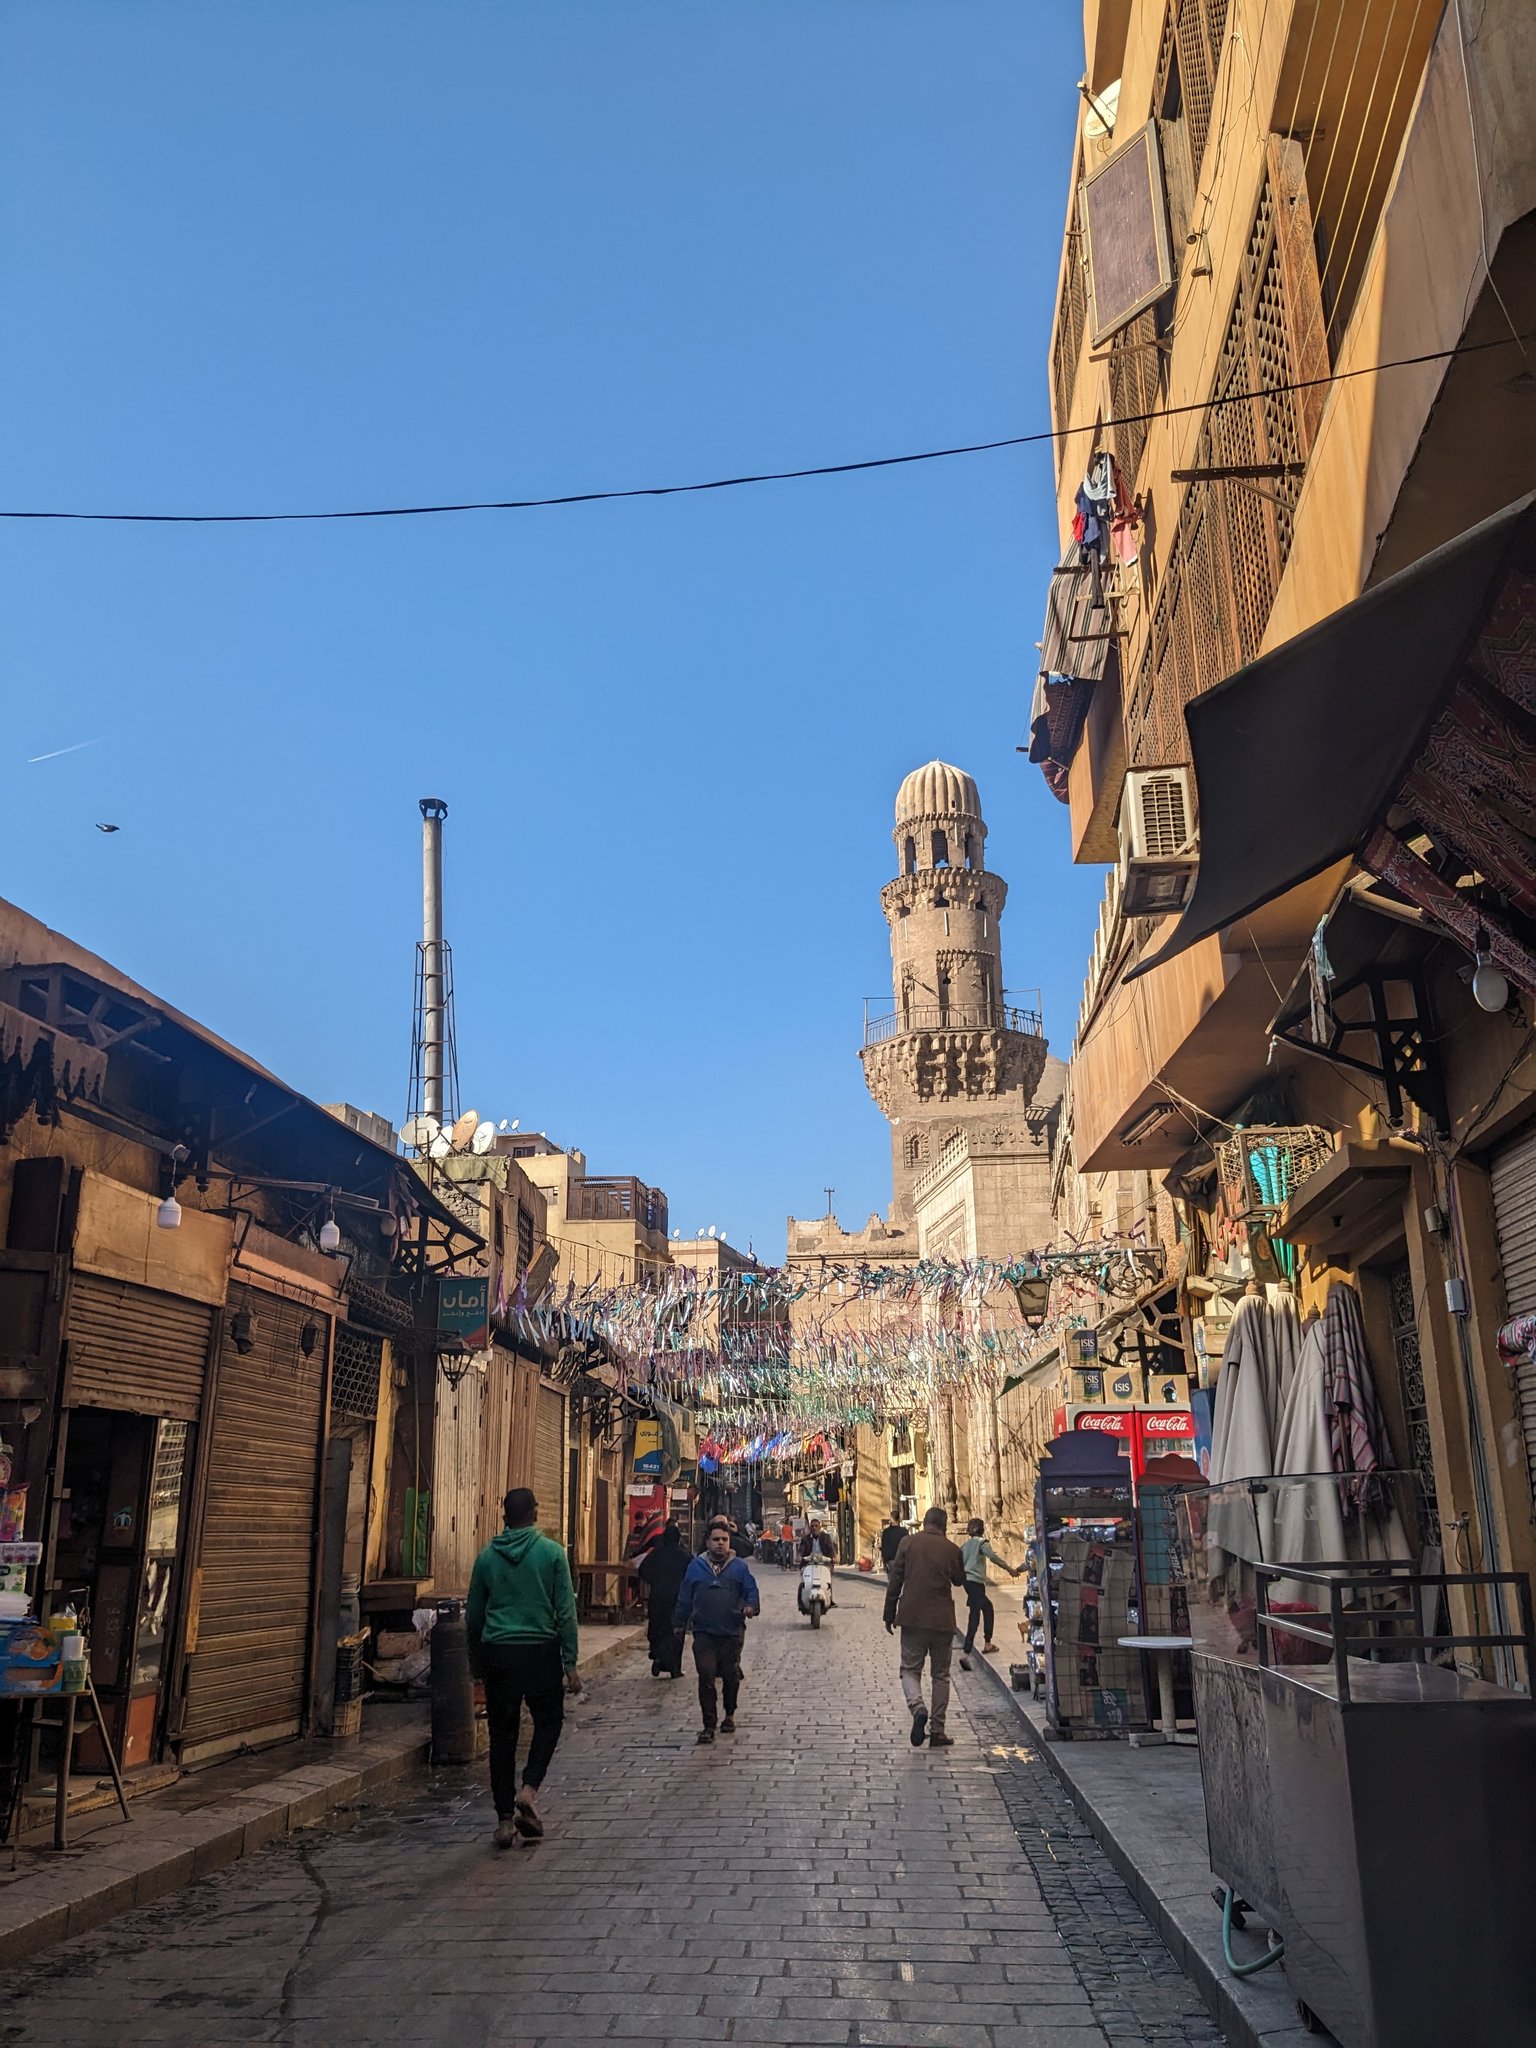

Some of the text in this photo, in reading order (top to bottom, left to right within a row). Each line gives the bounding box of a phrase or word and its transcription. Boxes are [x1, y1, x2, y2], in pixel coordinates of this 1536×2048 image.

[443, 1285, 486, 1309] أمان
[1081, 1338, 1095, 1347] ISIS
[1085, 1374, 1099, 1384] ISIS
[1114, 1382, 1130, 1392] ISIS
[1081, 1415, 1124, 1430] Coca-Cola
[1146, 1416, 1190, 1431] Coca-Cola
[1168, 1548, 1186, 1578] TIGER
